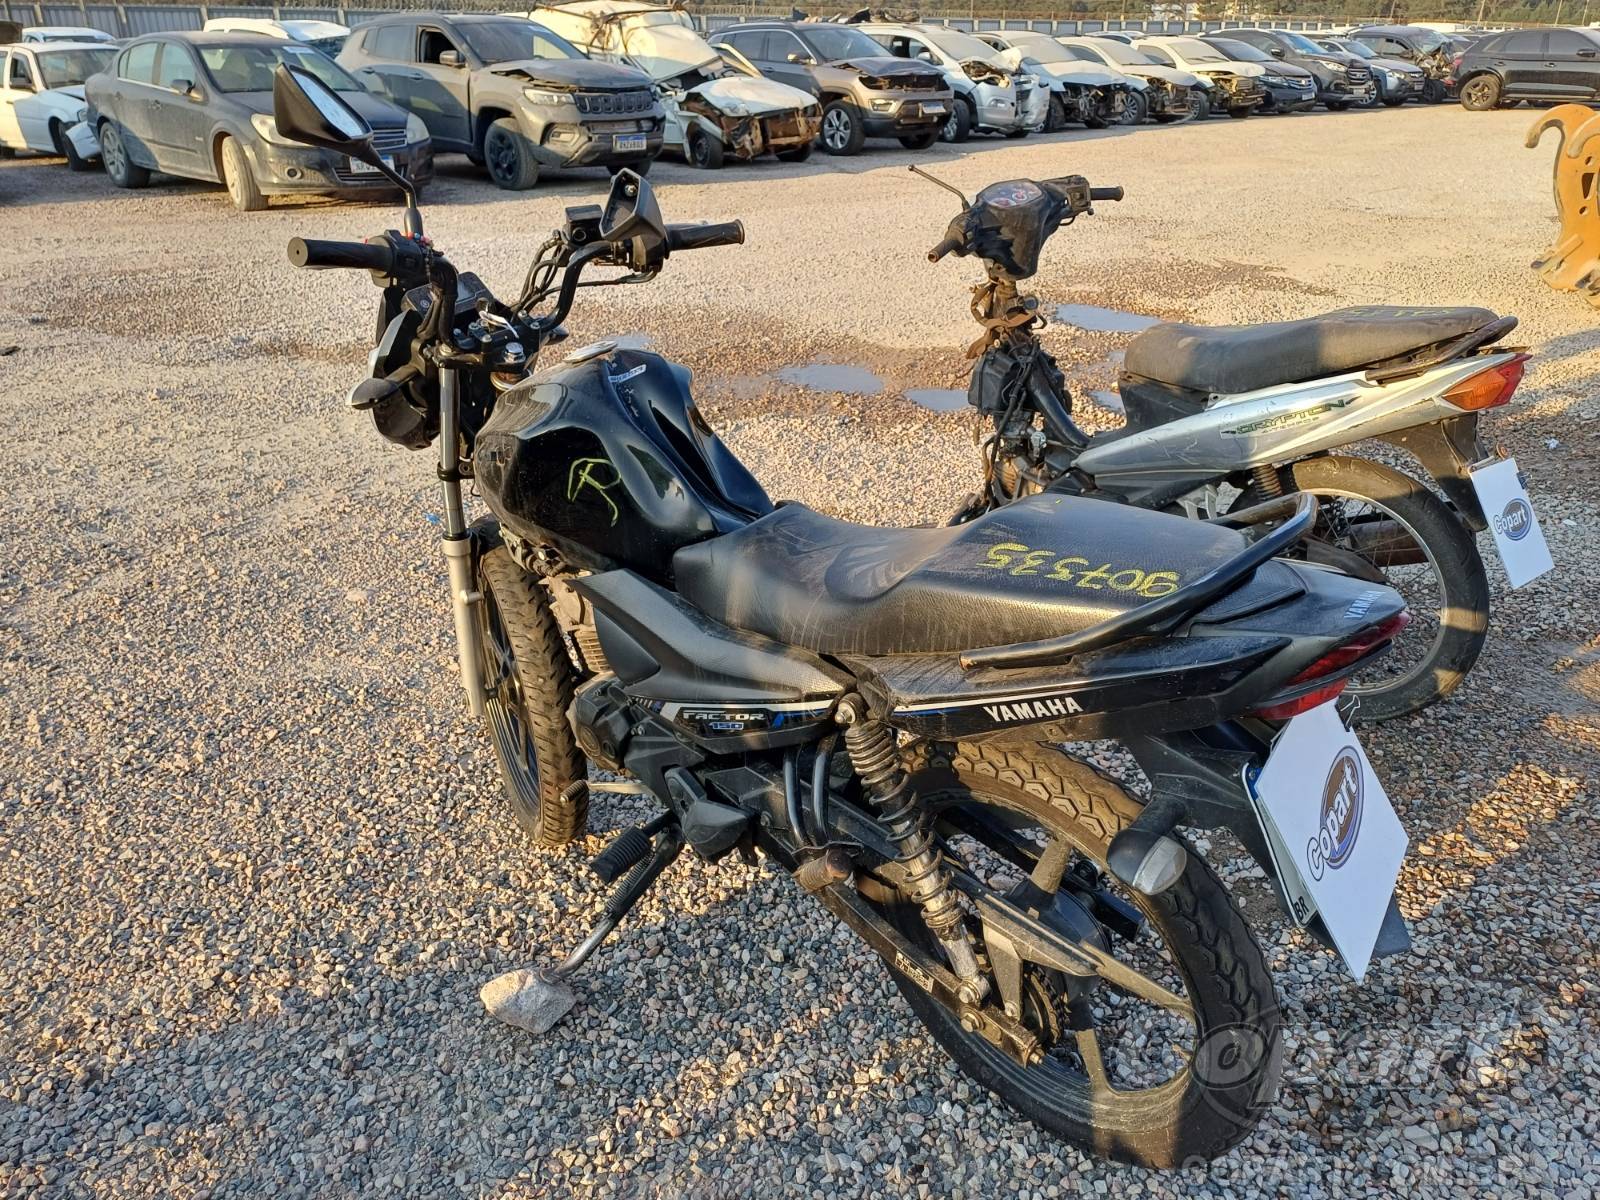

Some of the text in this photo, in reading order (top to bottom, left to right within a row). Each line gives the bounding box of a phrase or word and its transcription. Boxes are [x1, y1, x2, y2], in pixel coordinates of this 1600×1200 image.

[1236, 399, 1345, 435] CRYPTON
[1493, 505, 1528, 535] Copart
[976, 542, 1181, 597] 907535
[1343, 590, 1386, 618] YAMAHA
[683, 710, 766, 720] FACTOR
[983, 696, 1084, 722] YAMAHA
[709, 721, 744, 730] 150
[1306, 756, 1358, 882] Copart
[1293, 896, 1310, 921] BR
